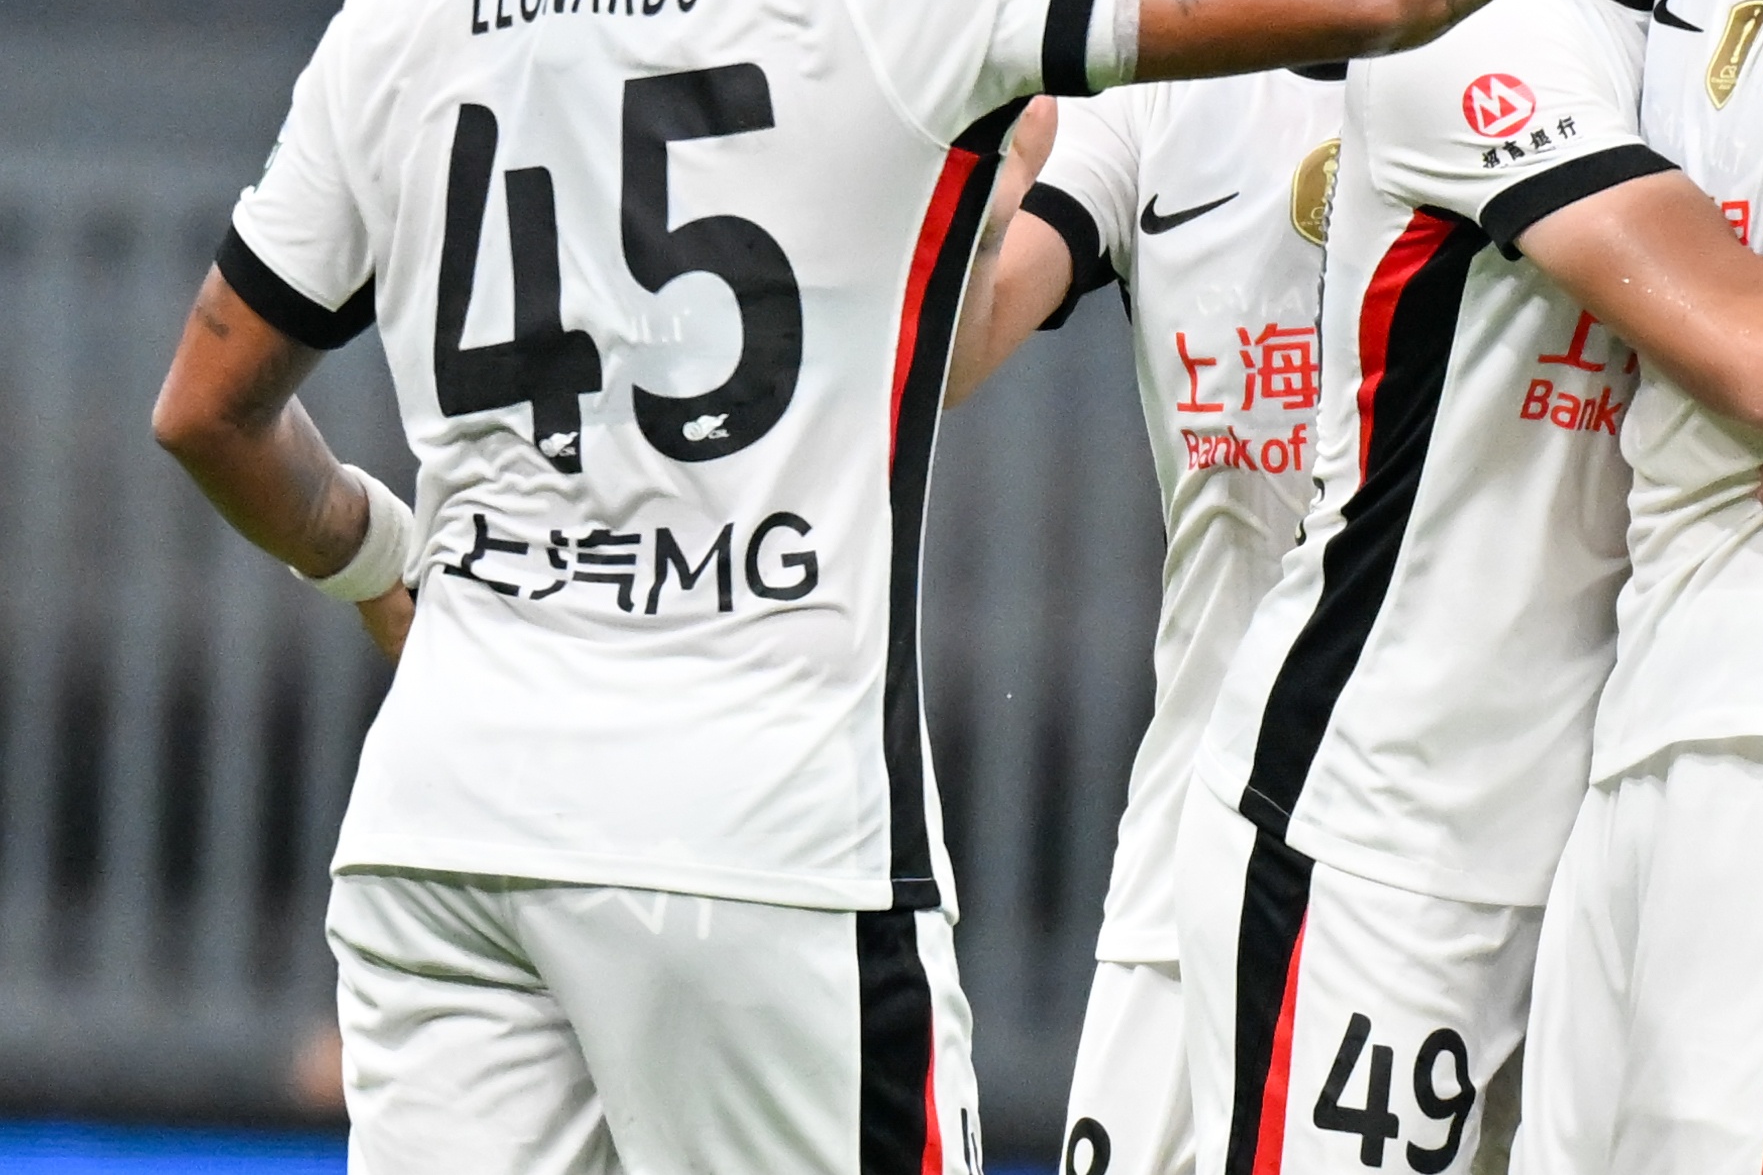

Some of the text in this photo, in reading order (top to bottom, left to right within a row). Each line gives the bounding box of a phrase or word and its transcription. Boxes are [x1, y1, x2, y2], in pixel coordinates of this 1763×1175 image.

[433, 62, 803, 475] 45
[1175, 322, 1319, 412] 上海
[1520, 378, 1624, 436] Bank
[1180, 422, 1308, 474] Bank of
[443, 511, 820, 616] 上汽MG
[1312, 1012, 1475, 1175] 49
